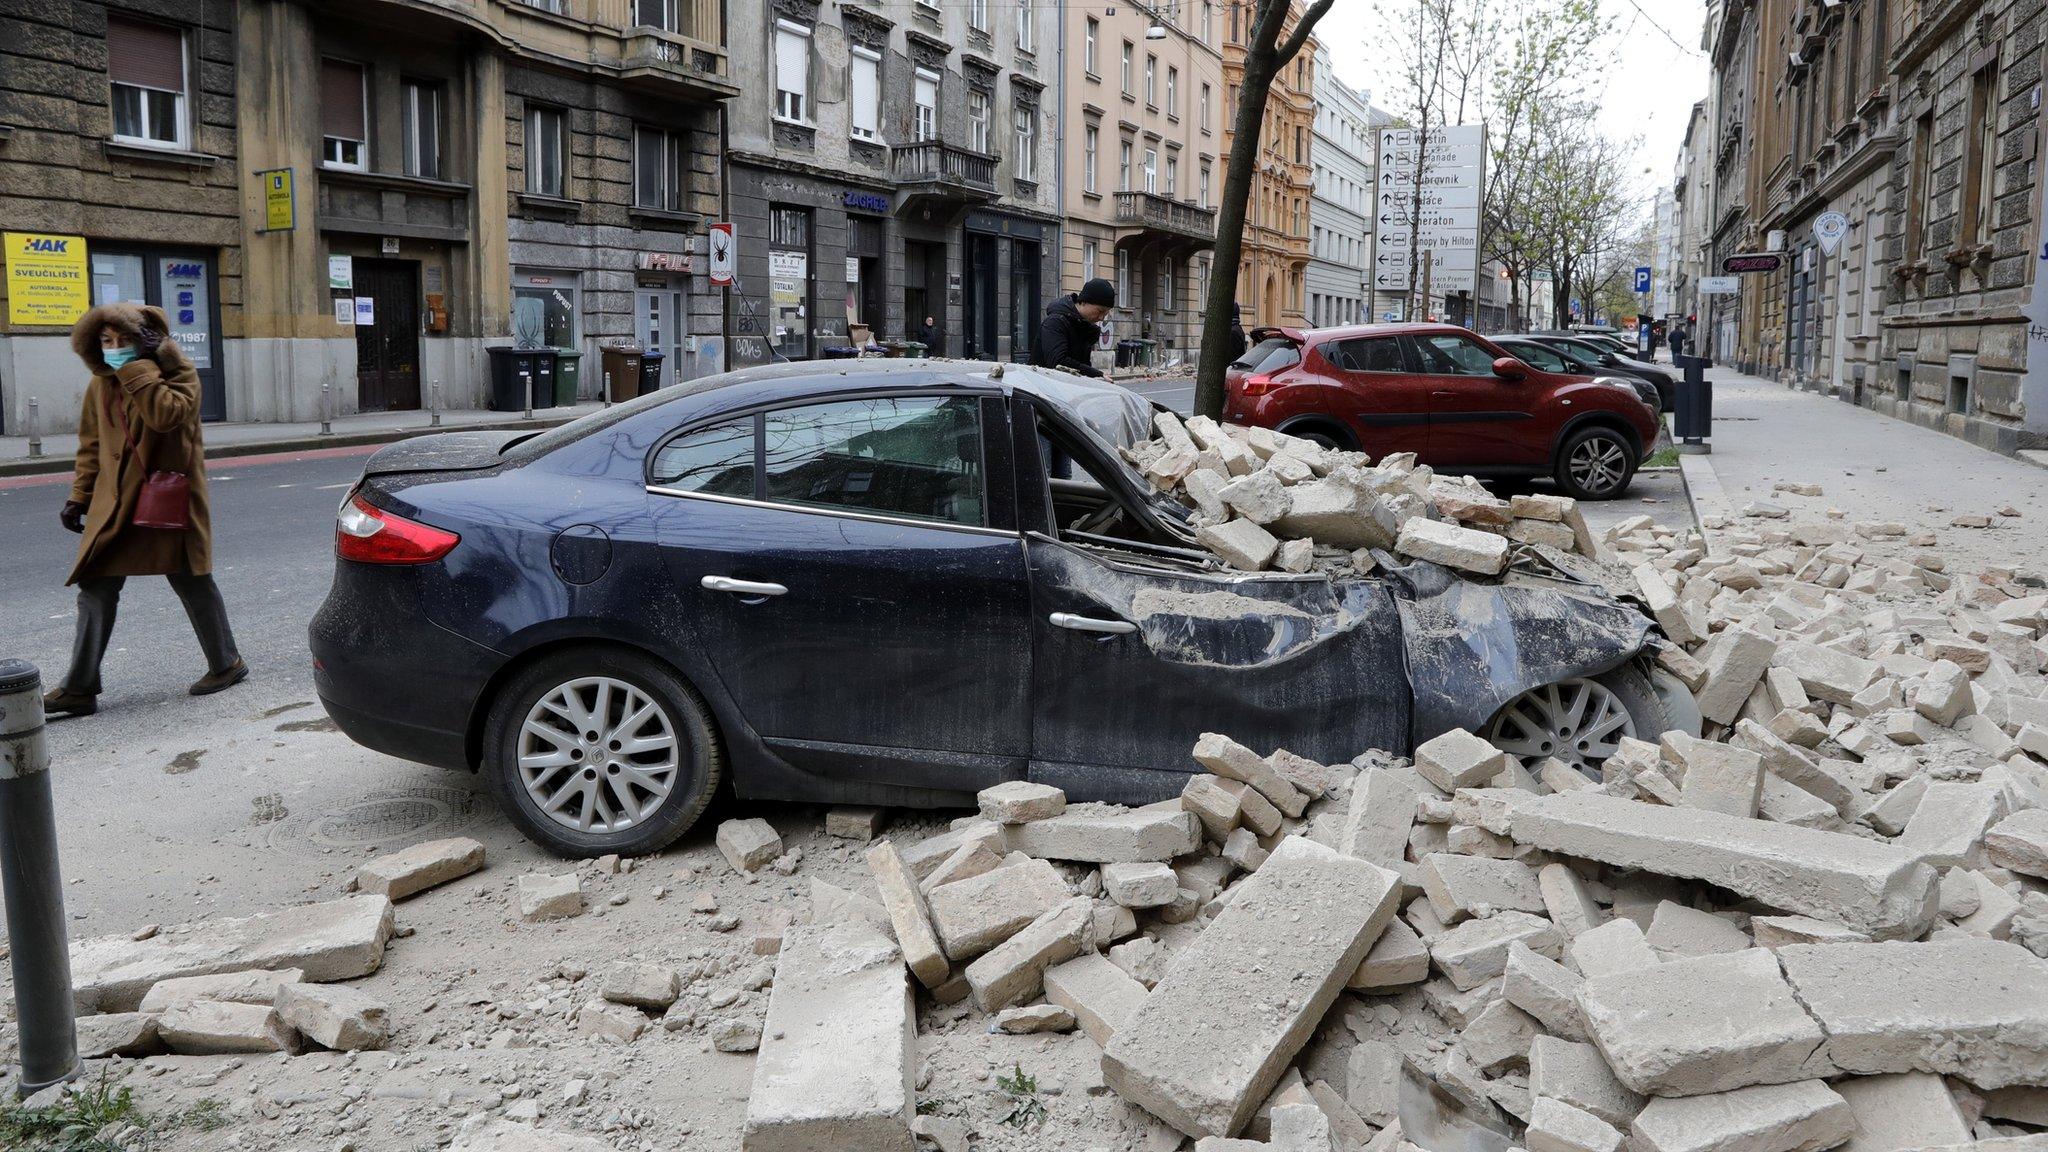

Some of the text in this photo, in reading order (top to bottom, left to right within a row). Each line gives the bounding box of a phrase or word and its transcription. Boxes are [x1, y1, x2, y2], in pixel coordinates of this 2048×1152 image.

[1414, 135, 1447, 144] Wstin
[1414, 153, 1457, 163] Eplanade
[844, 192, 889, 210] ZAGREB
[25, 238, 69, 253] HAK
[1440, 236, 1450, 247] by
[1451, 236, 1475, 245] Hilton
[15, 269, 80, 279] SVEUČILIŠTE
[1637, 272, 1649, 288] P
[552, 289, 572, 310] POPUST
[181, 333, 206, 342] 1987
